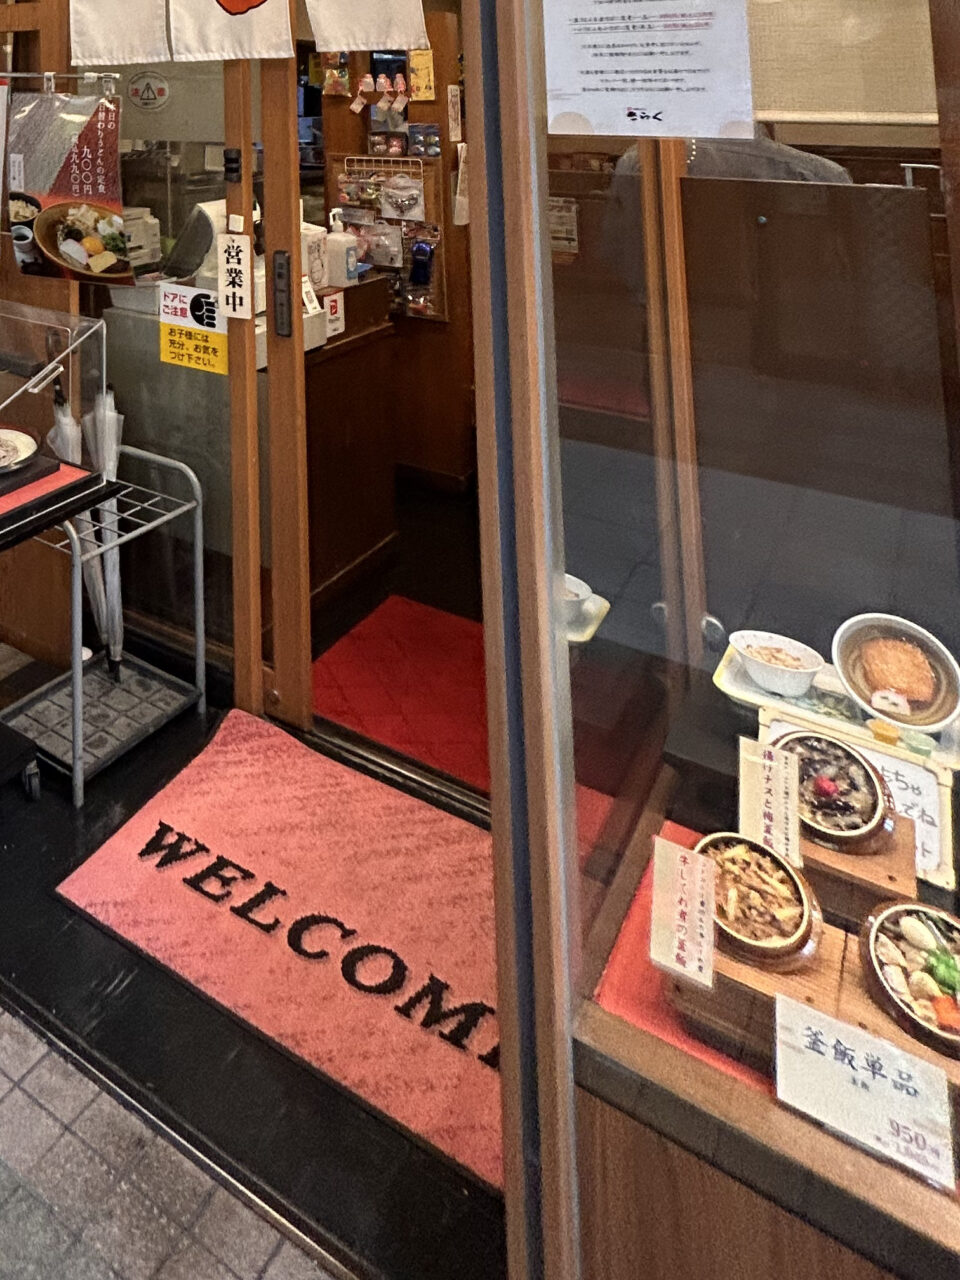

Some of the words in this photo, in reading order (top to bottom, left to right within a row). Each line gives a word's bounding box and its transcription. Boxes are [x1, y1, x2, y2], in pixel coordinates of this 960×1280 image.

[224, 244, 244, 312] 営業中
[162, 305, 189, 318] ご注意
[163, 292, 188, 305] ドアに
[803, 1026, 919, 1097] 釜飯単品
